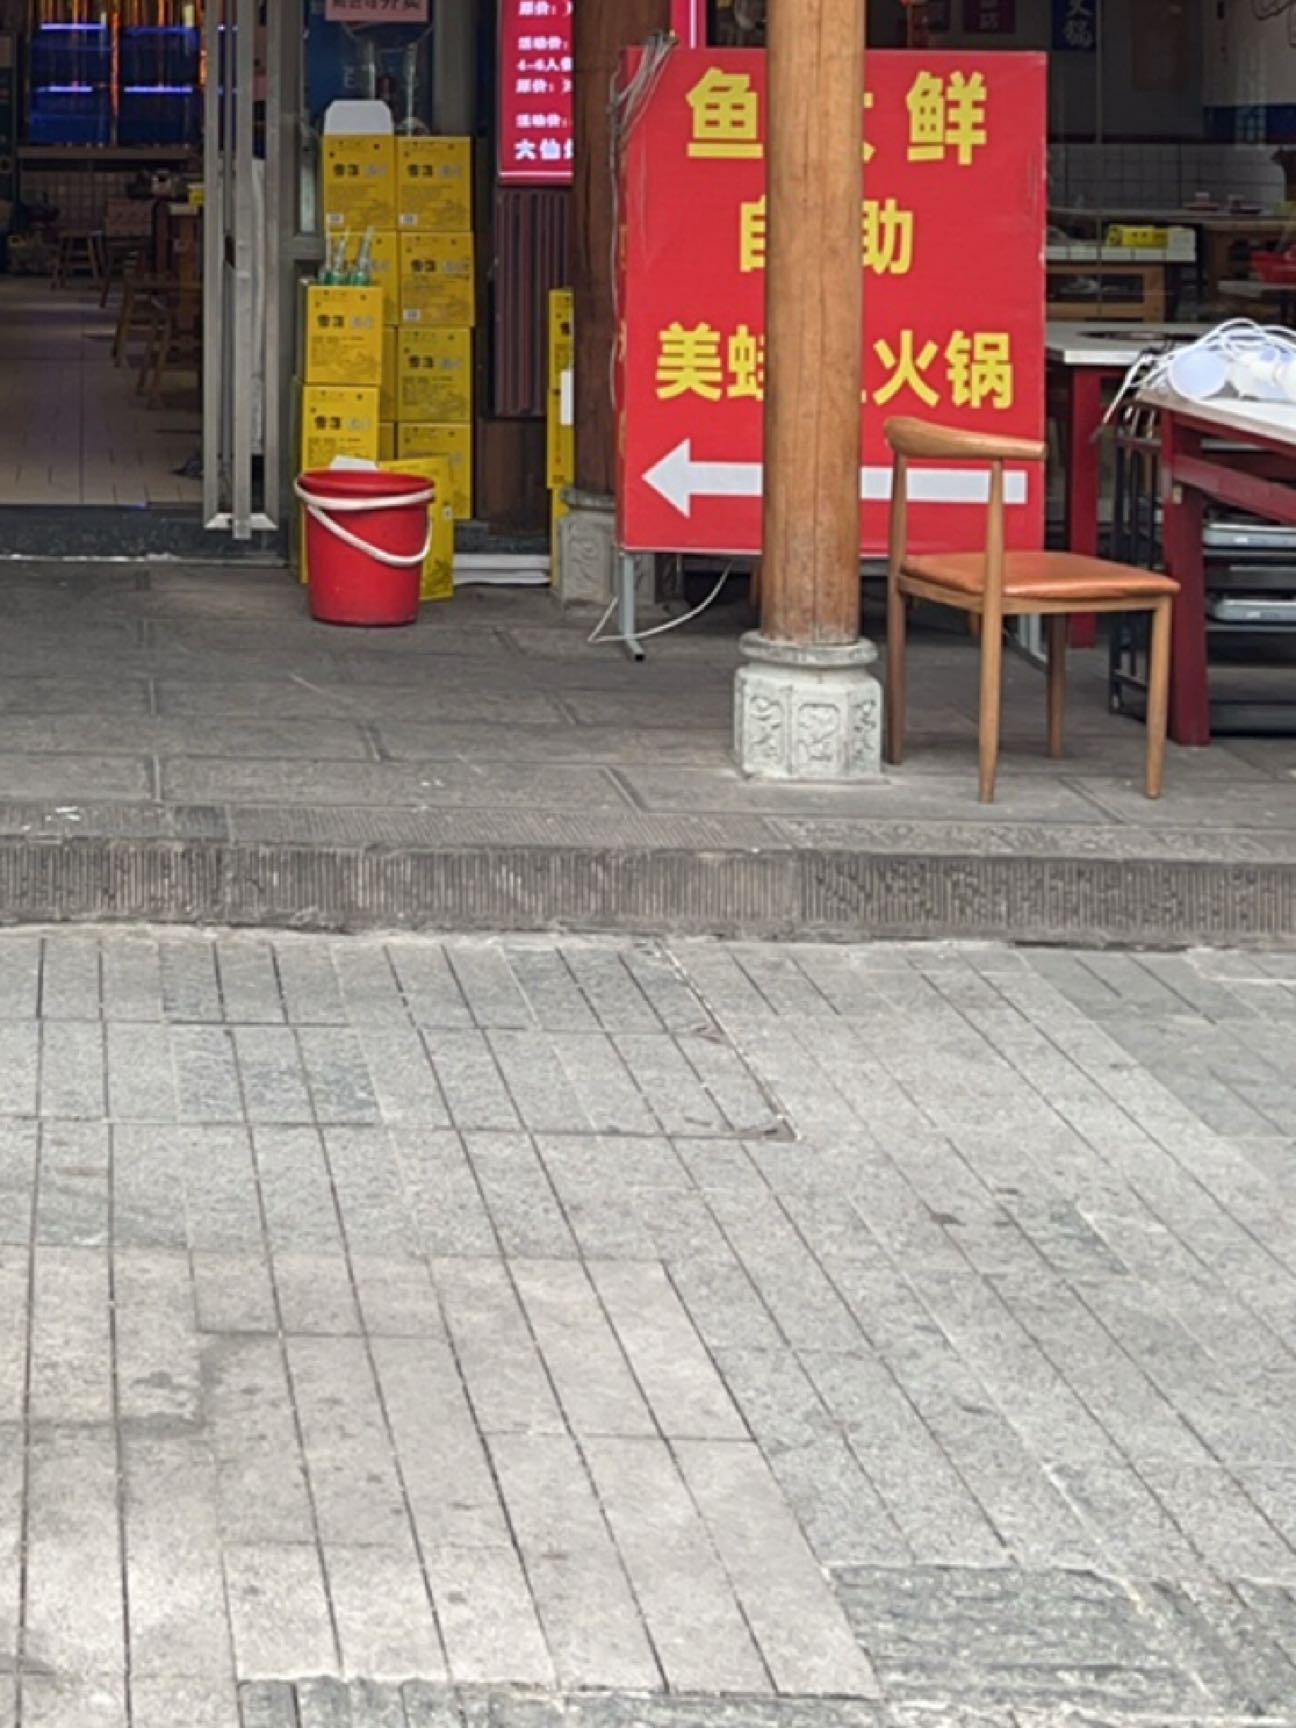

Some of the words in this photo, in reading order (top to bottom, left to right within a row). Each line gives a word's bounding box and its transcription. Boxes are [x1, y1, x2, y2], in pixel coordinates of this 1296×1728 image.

[685, 67, 988, 166] 鱼鲜
[655, 322, 1015, 409] 美蛙火锅
